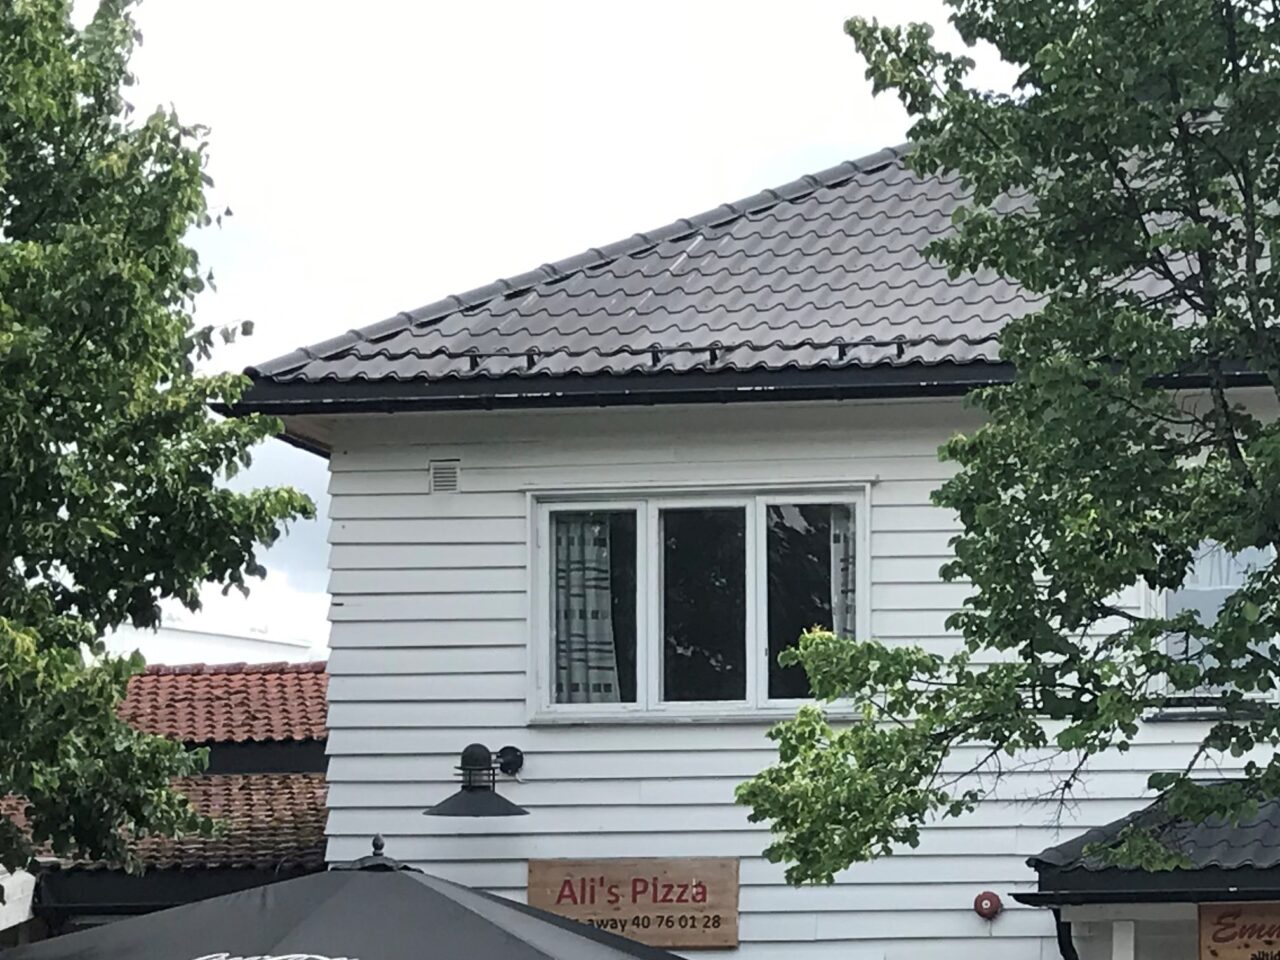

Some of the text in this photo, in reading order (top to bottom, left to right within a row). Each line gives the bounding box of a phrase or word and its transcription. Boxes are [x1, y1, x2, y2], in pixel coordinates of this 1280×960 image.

[556, 876, 708, 906] Ali's Pizza
[632, 915, 651, 929] 40
[657, 914, 675, 929] 76
[679, 914, 697, 929] 01
[703, 914, 722, 929] 28
